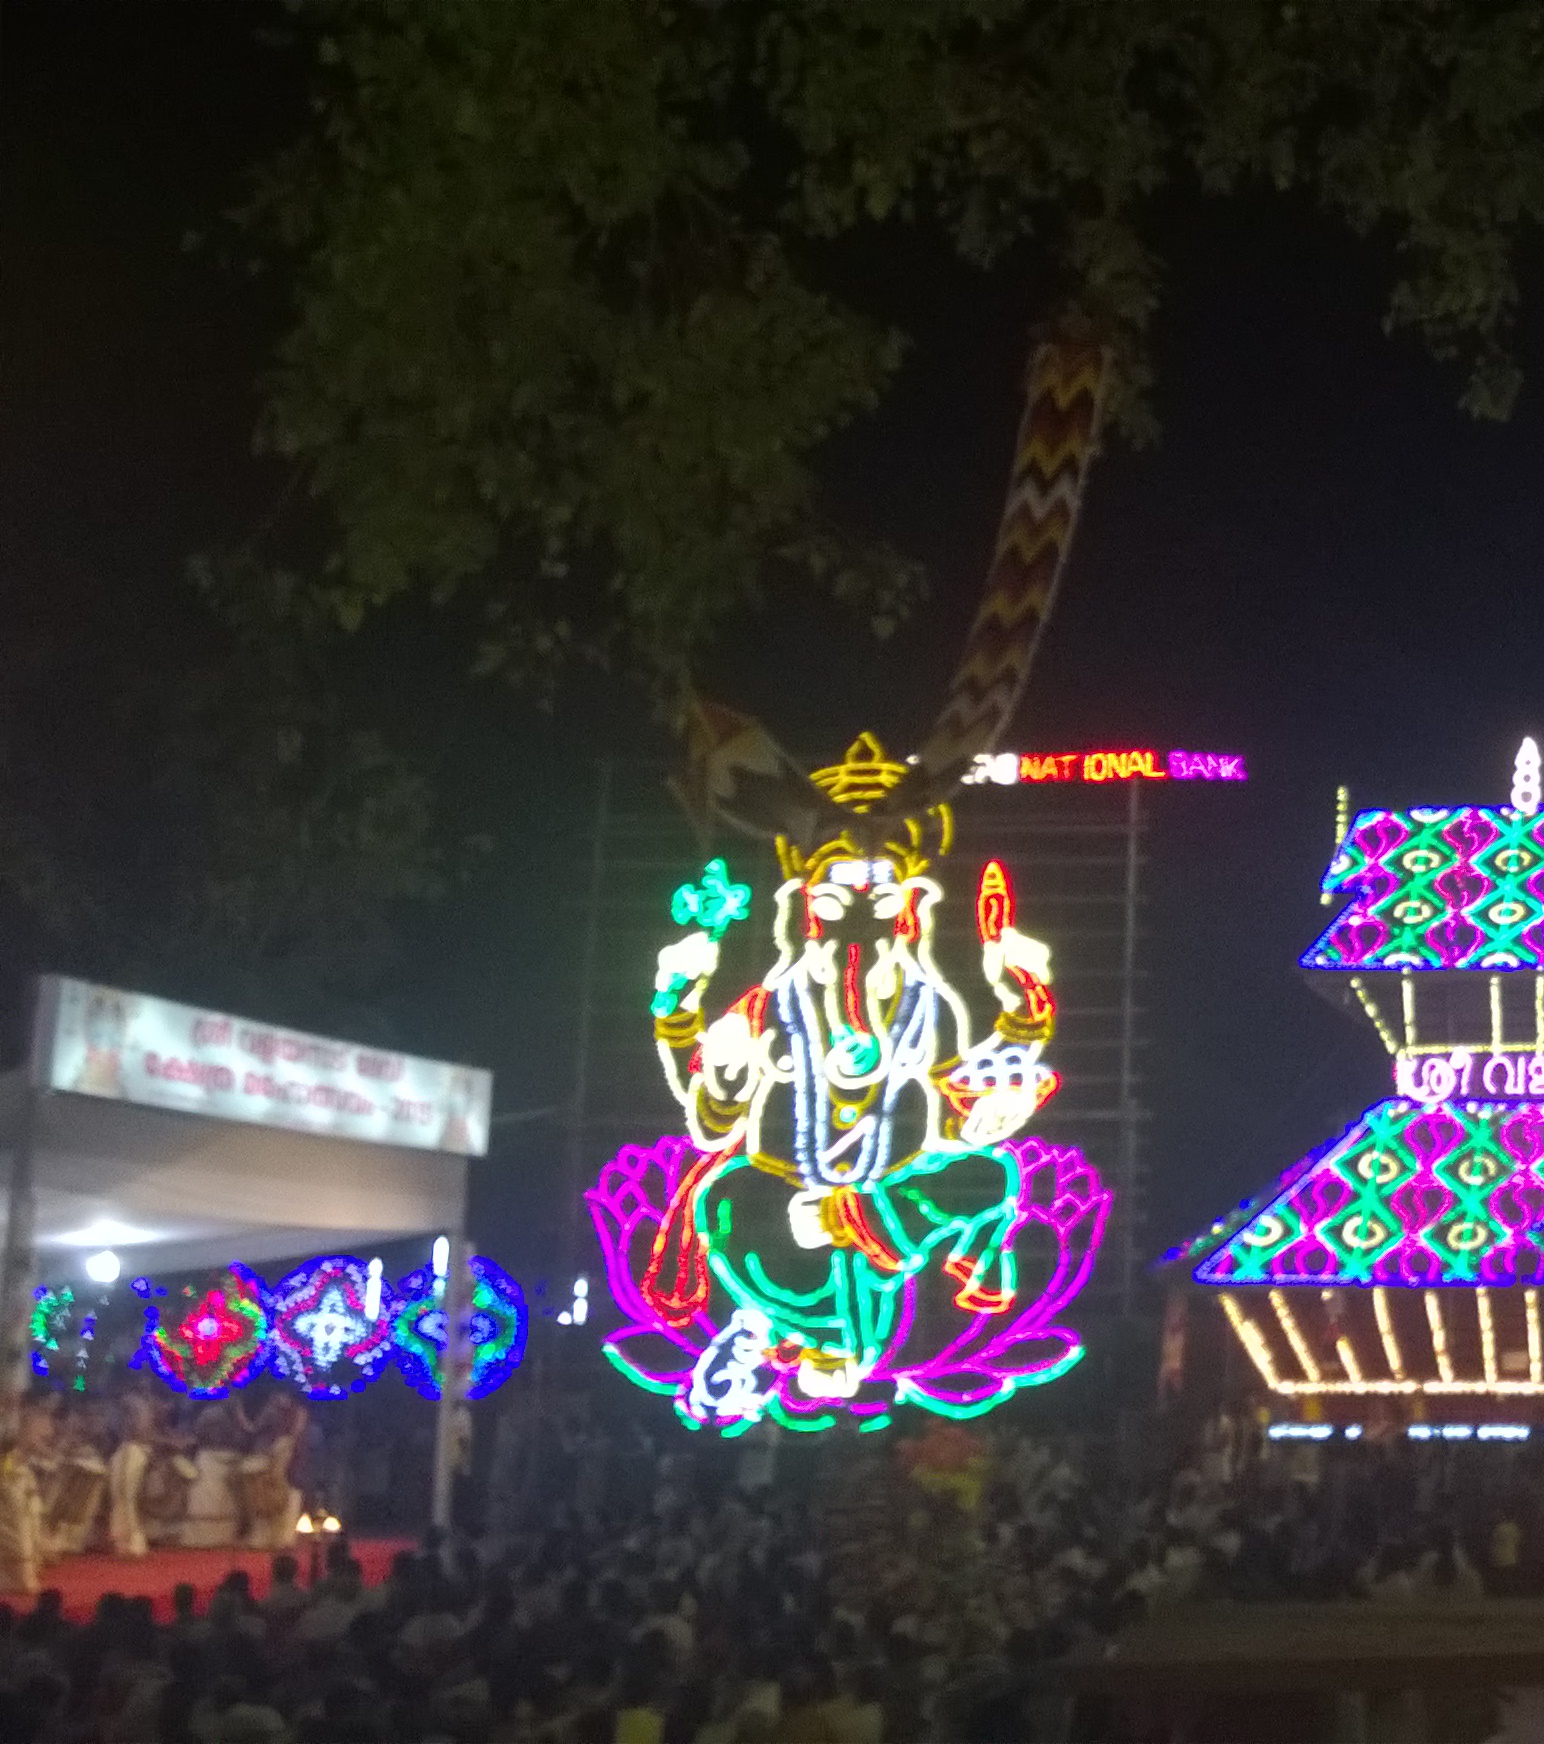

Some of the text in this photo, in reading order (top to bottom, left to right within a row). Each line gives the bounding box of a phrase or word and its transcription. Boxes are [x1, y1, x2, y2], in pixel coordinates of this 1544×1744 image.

[1019, 750, 1167, 784] NATIONAL
[1168, 748, 1248, 782] BANK
[1397, 1046, 1473, 1102] ശ്രീ
